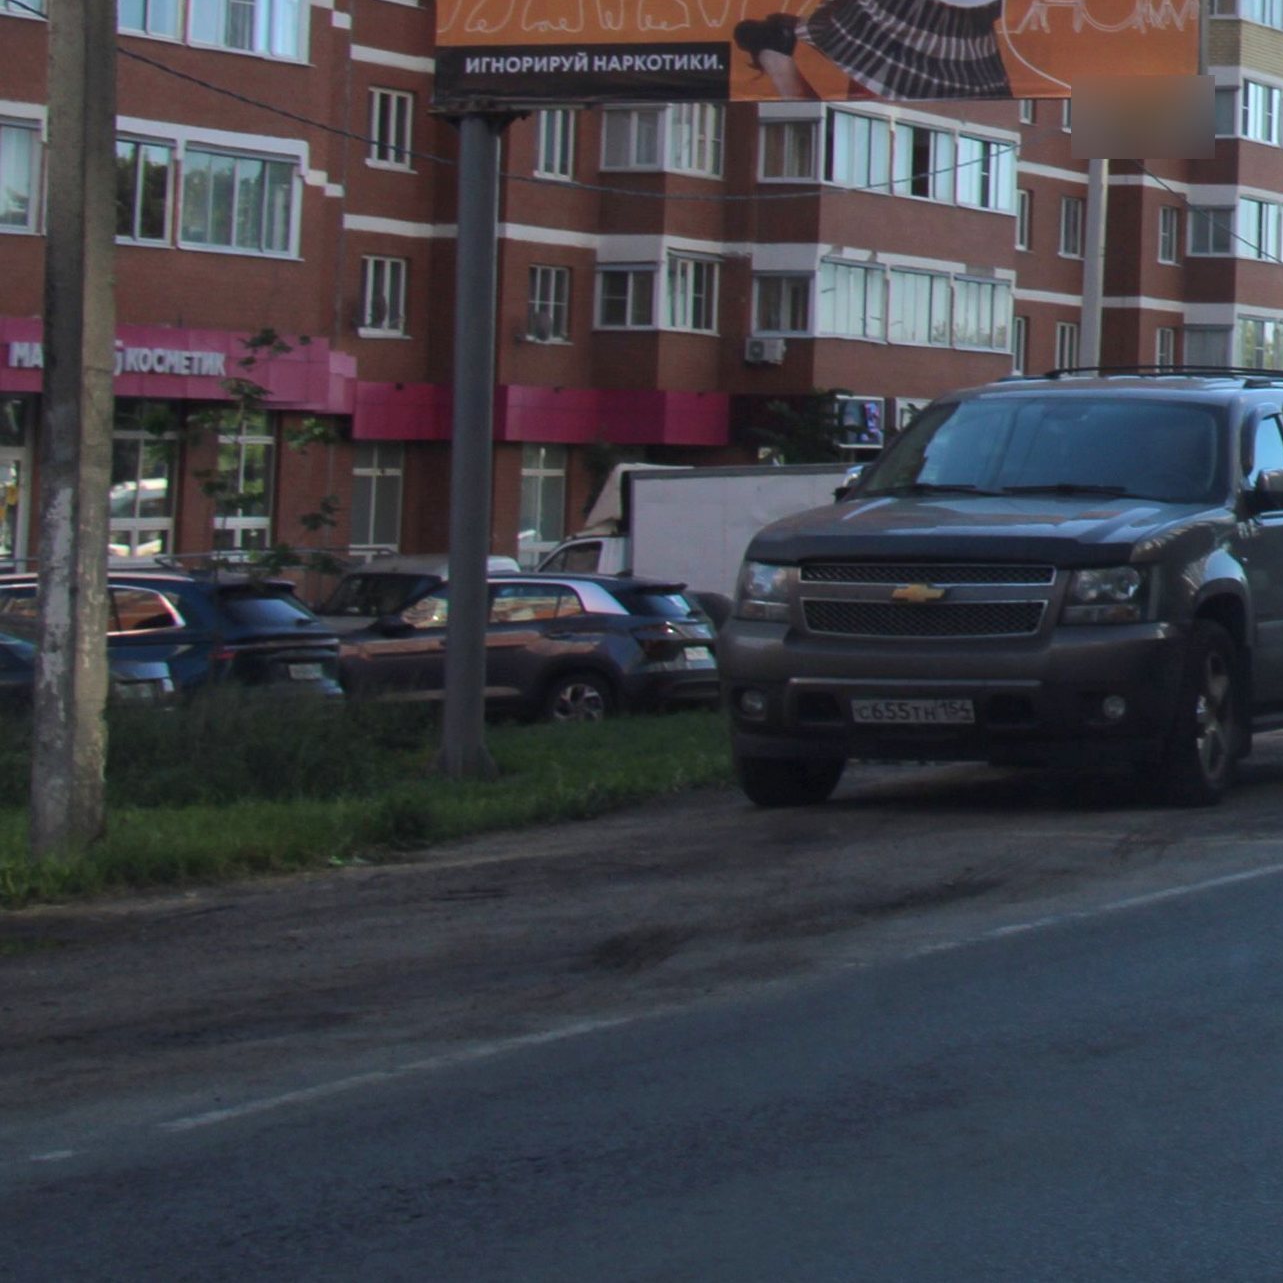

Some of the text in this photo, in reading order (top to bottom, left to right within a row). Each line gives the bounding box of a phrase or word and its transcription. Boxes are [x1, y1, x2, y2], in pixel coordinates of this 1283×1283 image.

[464, 50, 725, 75] ИГНОРИРУЙ НАРКОТИКИ.
[123, 347, 226, 377] КОСМЕТИК
